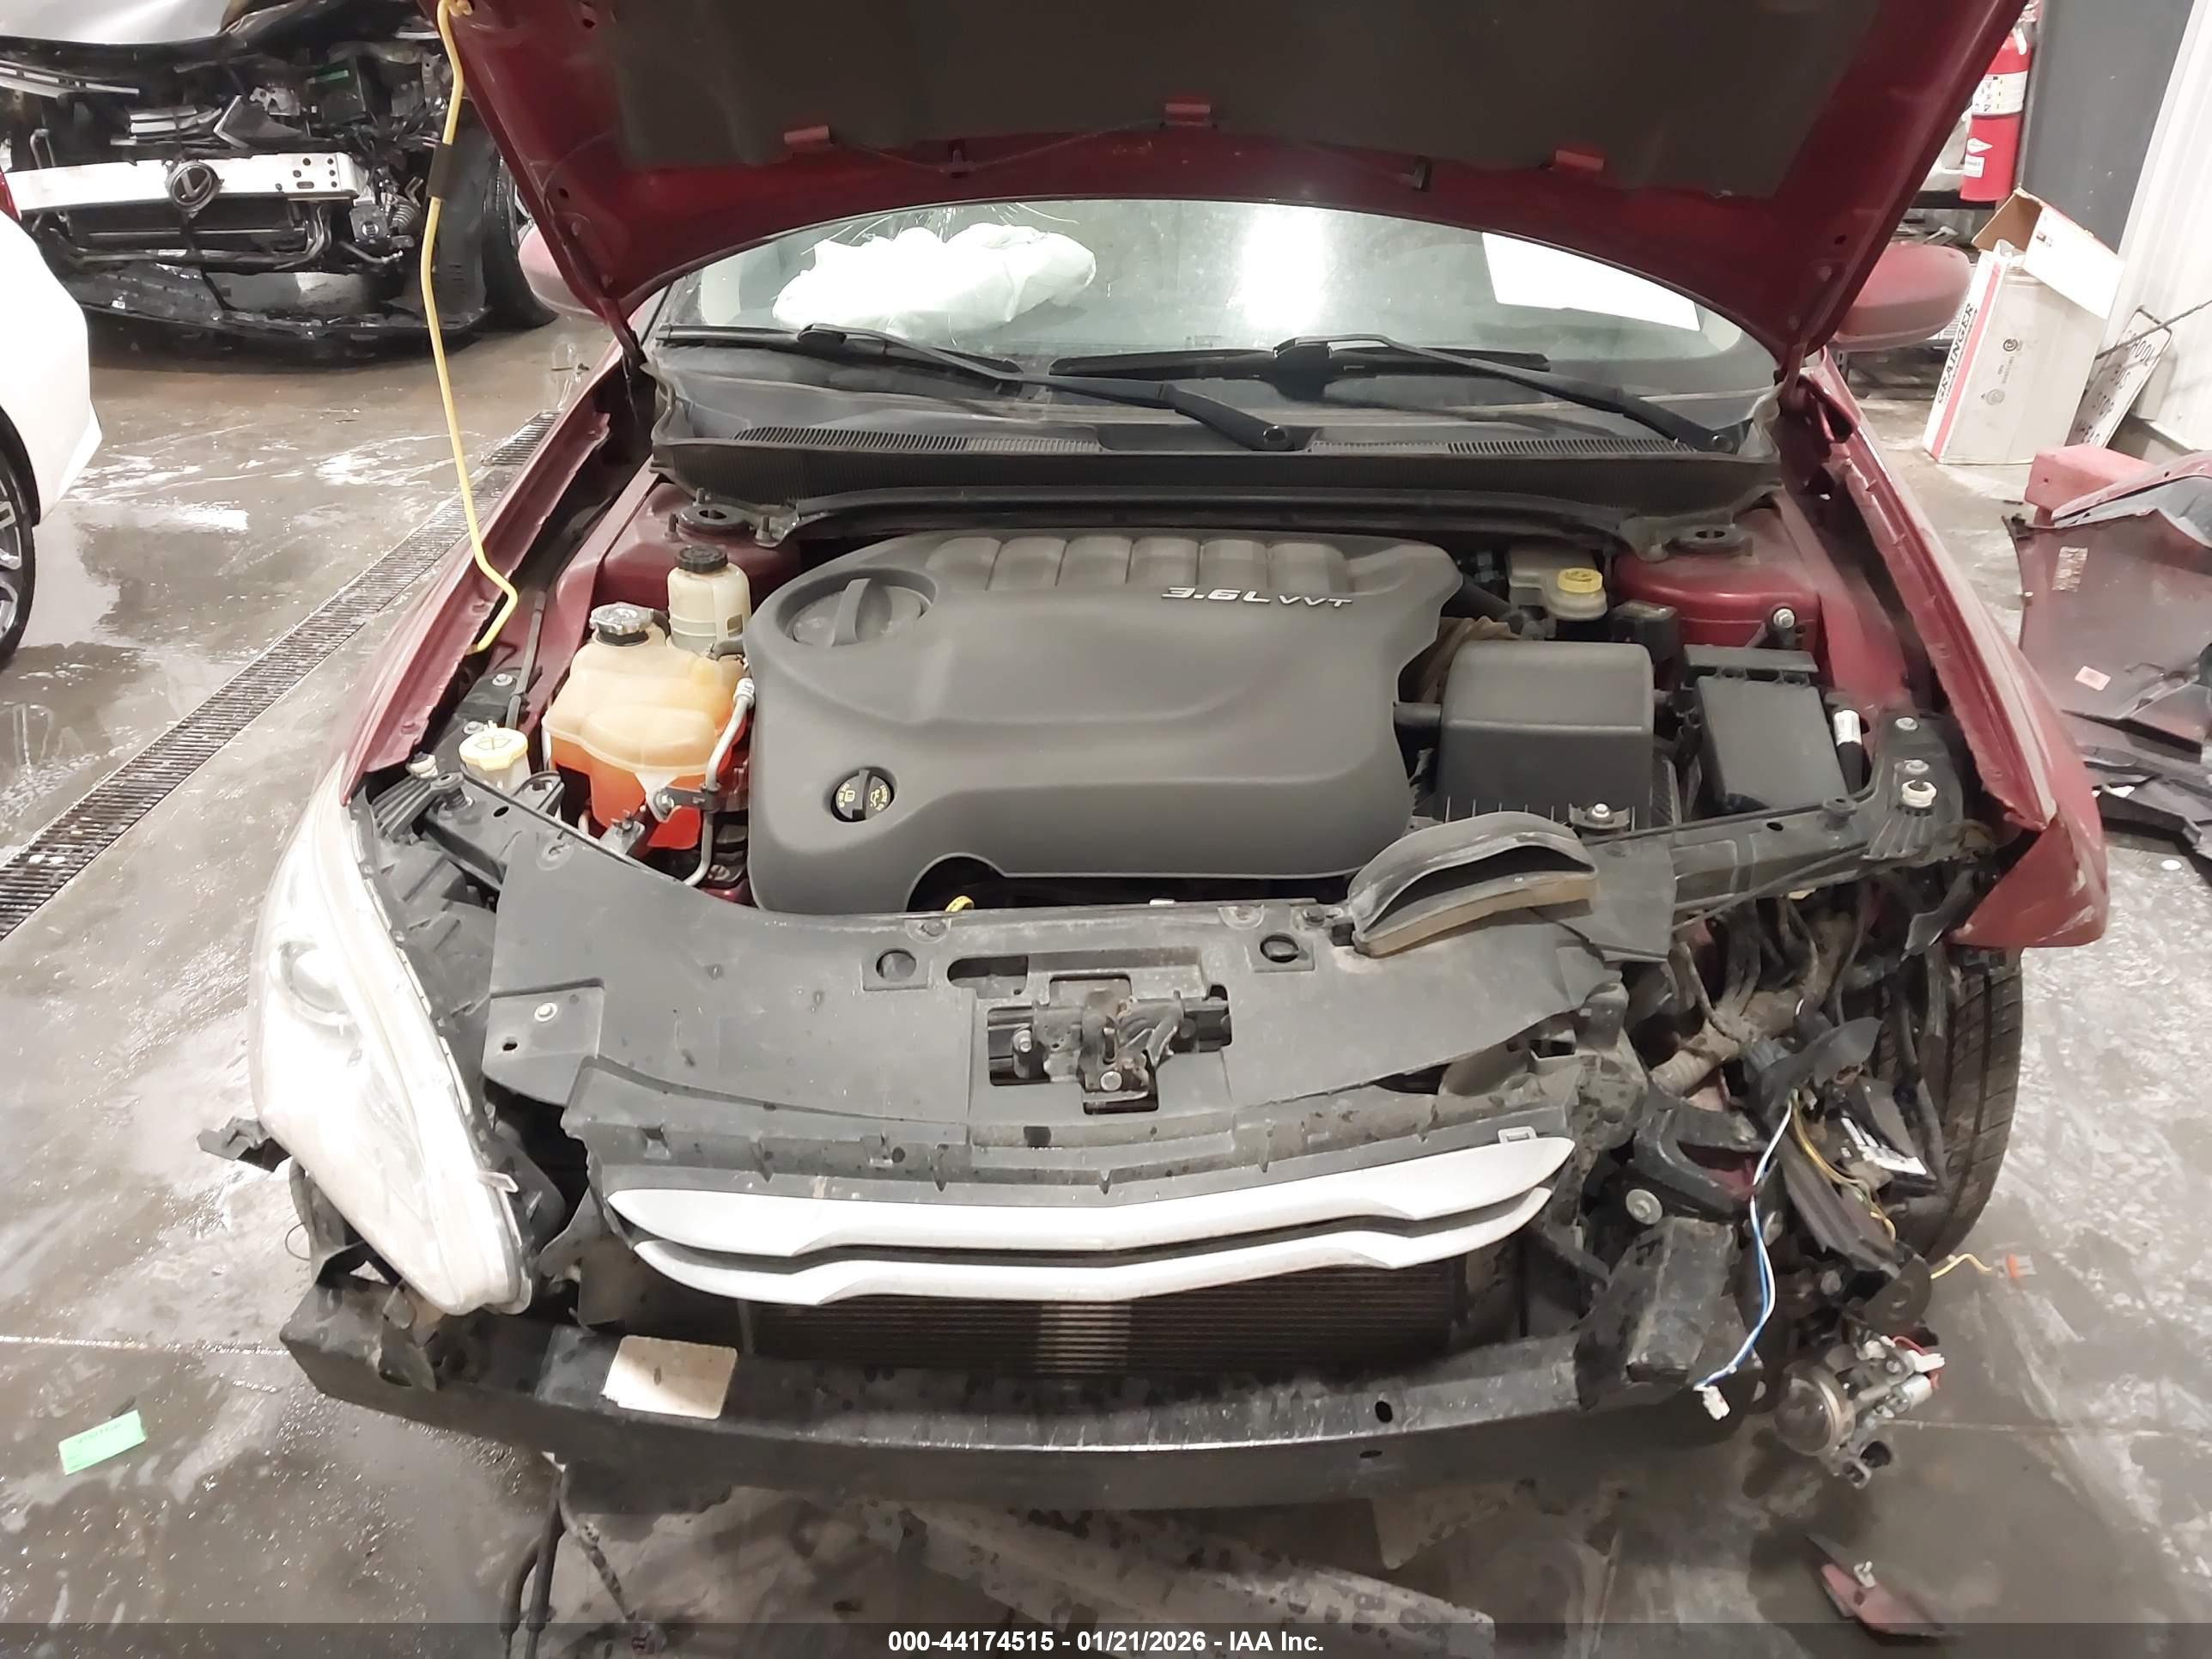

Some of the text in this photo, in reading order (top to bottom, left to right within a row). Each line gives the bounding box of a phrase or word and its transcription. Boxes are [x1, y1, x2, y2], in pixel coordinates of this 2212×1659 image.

[1938, 303, 1973, 404] GRAINGER
[1161, 586, 1352, 607] 3.6L VVT
